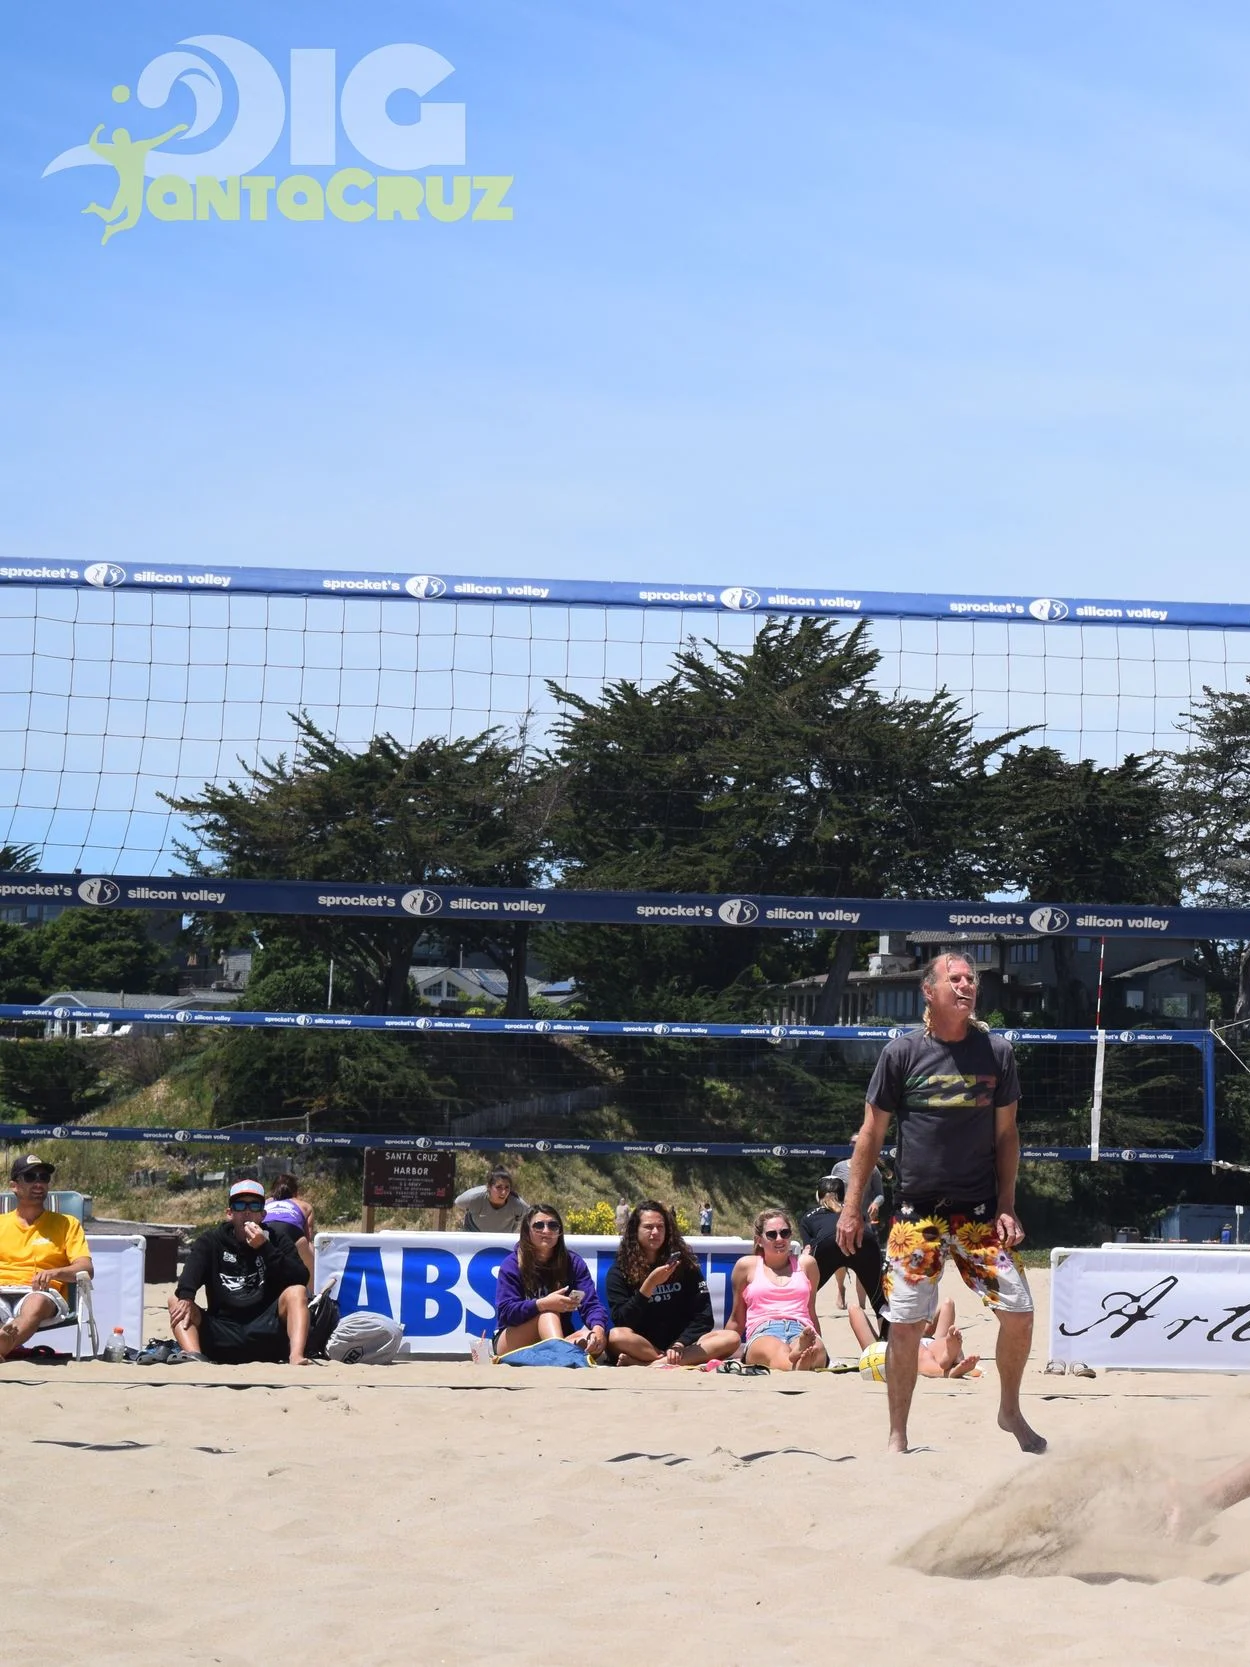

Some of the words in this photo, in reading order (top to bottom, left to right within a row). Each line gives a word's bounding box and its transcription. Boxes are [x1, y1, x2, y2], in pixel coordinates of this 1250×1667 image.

[0, 567, 79, 579] sprocket's
[134, 571, 183, 583] silicon
[187, 574, 231, 586] volley
[323, 579, 400, 590] sprocket's
[454, 583, 502, 594] silicon
[506, 585, 549, 597] volley
[640, 591, 715, 602] sprocket's
[768, 595, 815, 606] silicon
[819, 597, 861, 609] volley
[950, 602, 1024, 613] sprocket's
[1076, 606, 1122, 617] silicon
[1126, 608, 1167, 620] volley
[128, 888, 177, 899] silicon
[182, 890, 225, 903] volley
[318, 895, 395, 907] sprocket's
[450, 898, 498, 910] silicon
[503, 900, 545, 914] volley
[637, 905, 712, 917] sprocket's
[766, 908, 813, 919] silicon
[818, 910, 860, 923] volley
[949, 913, 1024, 925] sprocket's
[1076, 916, 1123, 927] silicon
[1128, 917, 1168, 930] volley
[385, 1152, 412, 1161] SANTA
[416, 1153, 439, 1162] CRUZ
[393, 1166, 429, 1176] HARBOR
